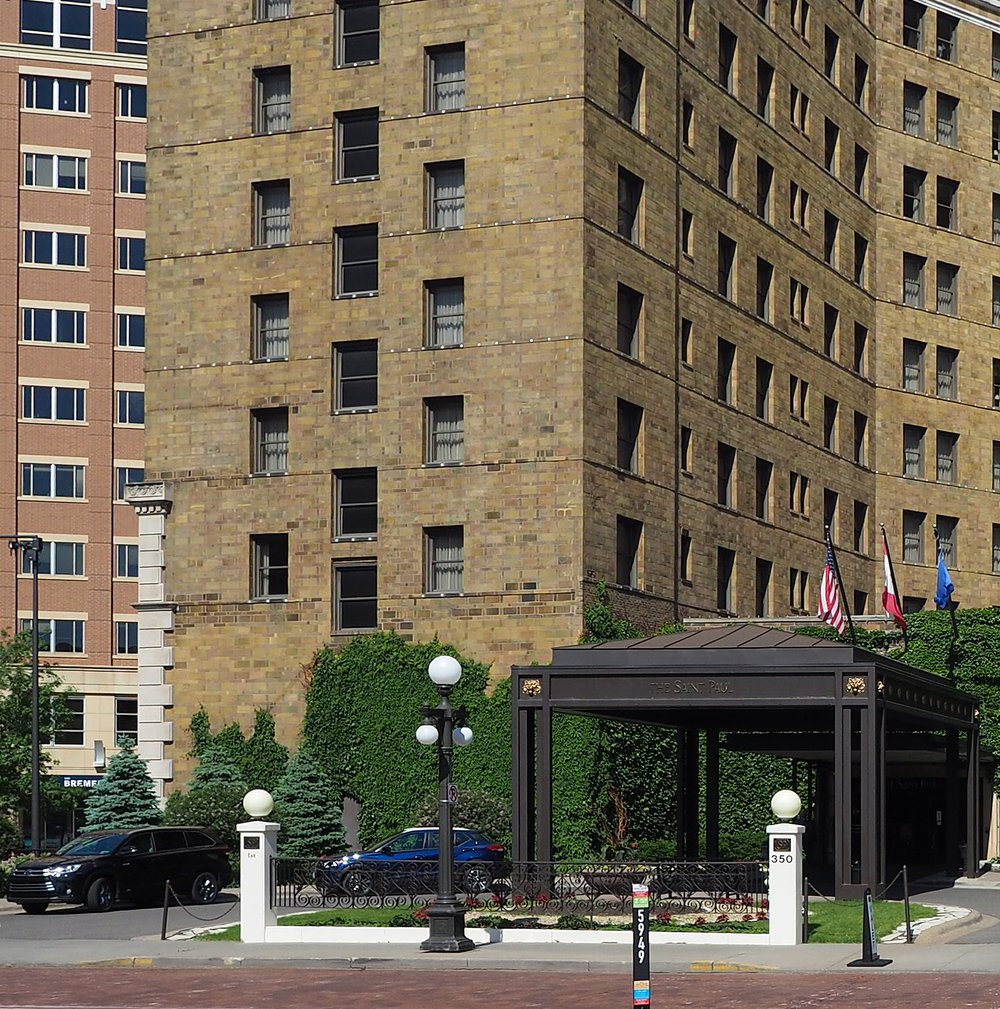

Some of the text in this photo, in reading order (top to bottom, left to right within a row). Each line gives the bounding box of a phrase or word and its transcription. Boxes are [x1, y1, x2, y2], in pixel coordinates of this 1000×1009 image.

[64, 779, 100, 788] BREME
[771, 854, 794, 864] 350
[637, 908, 646, 964] 5949
